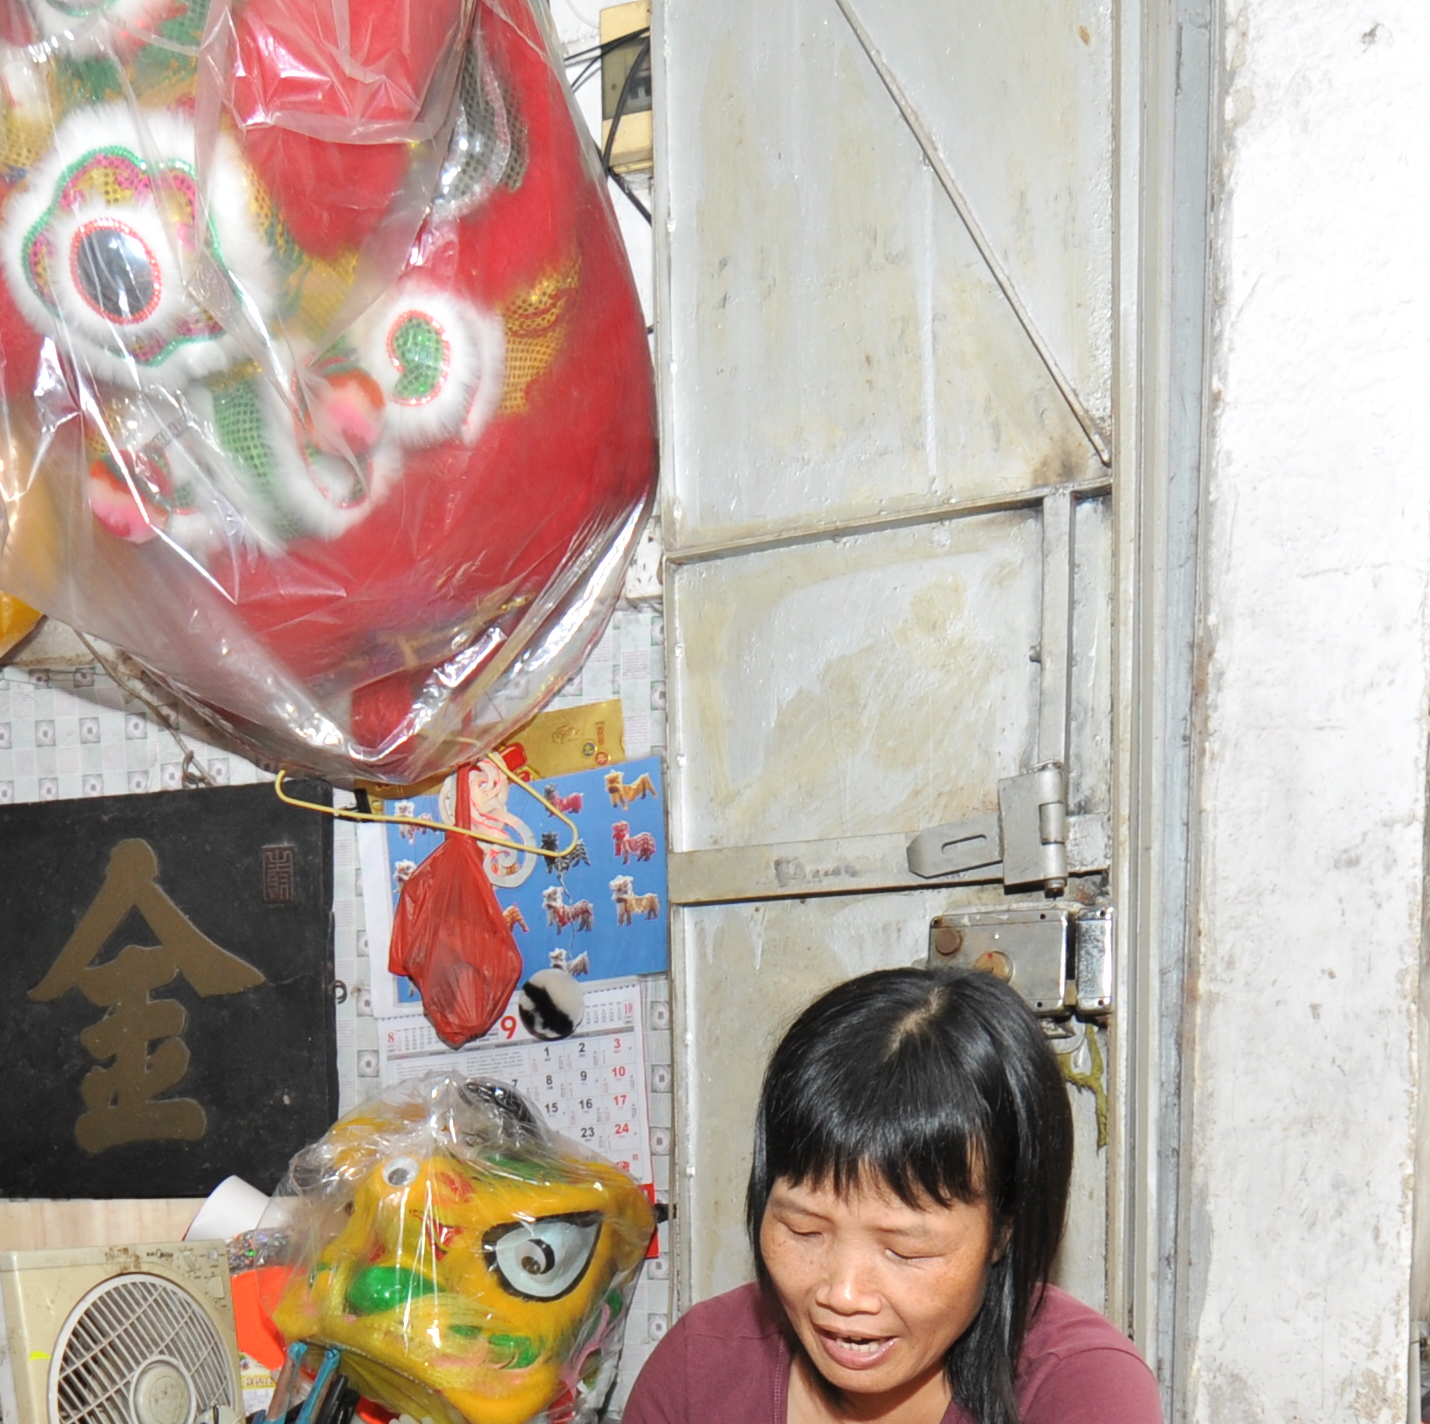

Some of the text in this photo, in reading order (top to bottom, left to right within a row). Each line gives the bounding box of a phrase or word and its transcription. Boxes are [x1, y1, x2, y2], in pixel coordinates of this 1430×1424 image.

[500, 1015, 517, 1040] 9
[387, 1032, 395, 1044] 8
[544, 1038, 621, 1057] 1 2 3
[546, 1074, 553, 1085] 8
[580, 1070, 587, 1081] 9
[612, 1066, 626, 1078] 10
[545, 1095, 627, 1114] 15 16 17
[581, 1122, 629, 1138] 23 24
